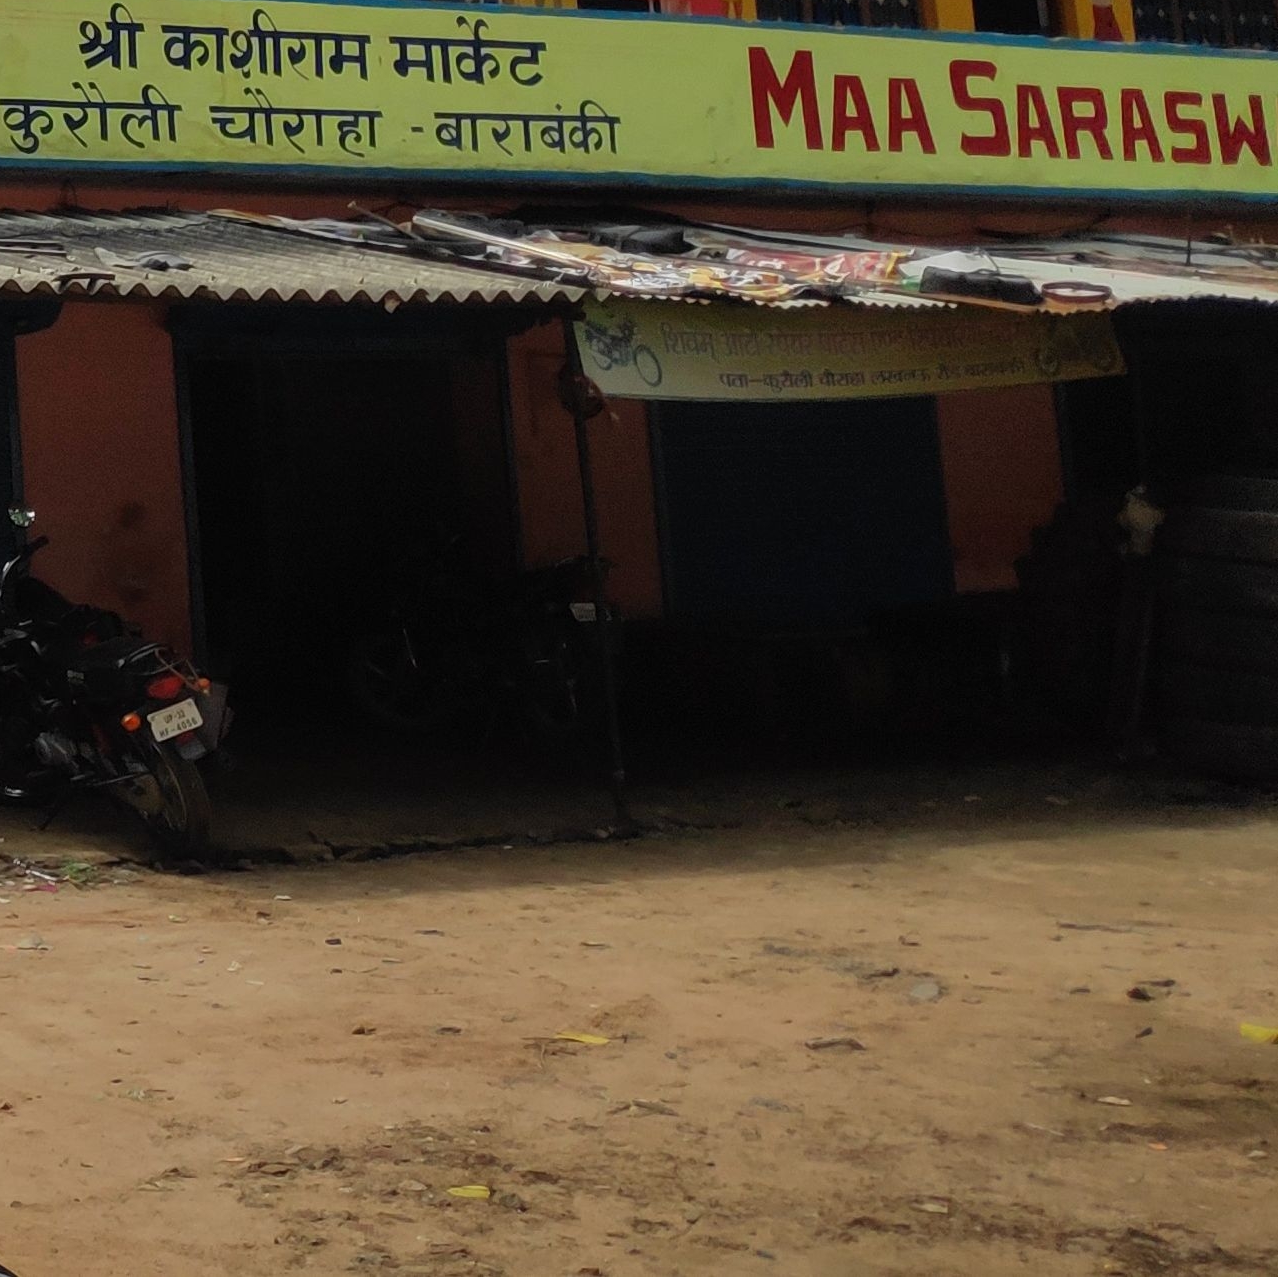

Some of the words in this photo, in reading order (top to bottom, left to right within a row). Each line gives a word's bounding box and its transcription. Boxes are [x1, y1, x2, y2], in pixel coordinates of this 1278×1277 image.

[78, 3, 145, 71] श्री
[160, 8, 371, 82] काशीराम
[389, 15, 547, 88] मार्केट
[209, 86, 383, 158] चौराहा
[747, 46, 938, 155] MAA
[948, 59, 1278, 168] SARASW
